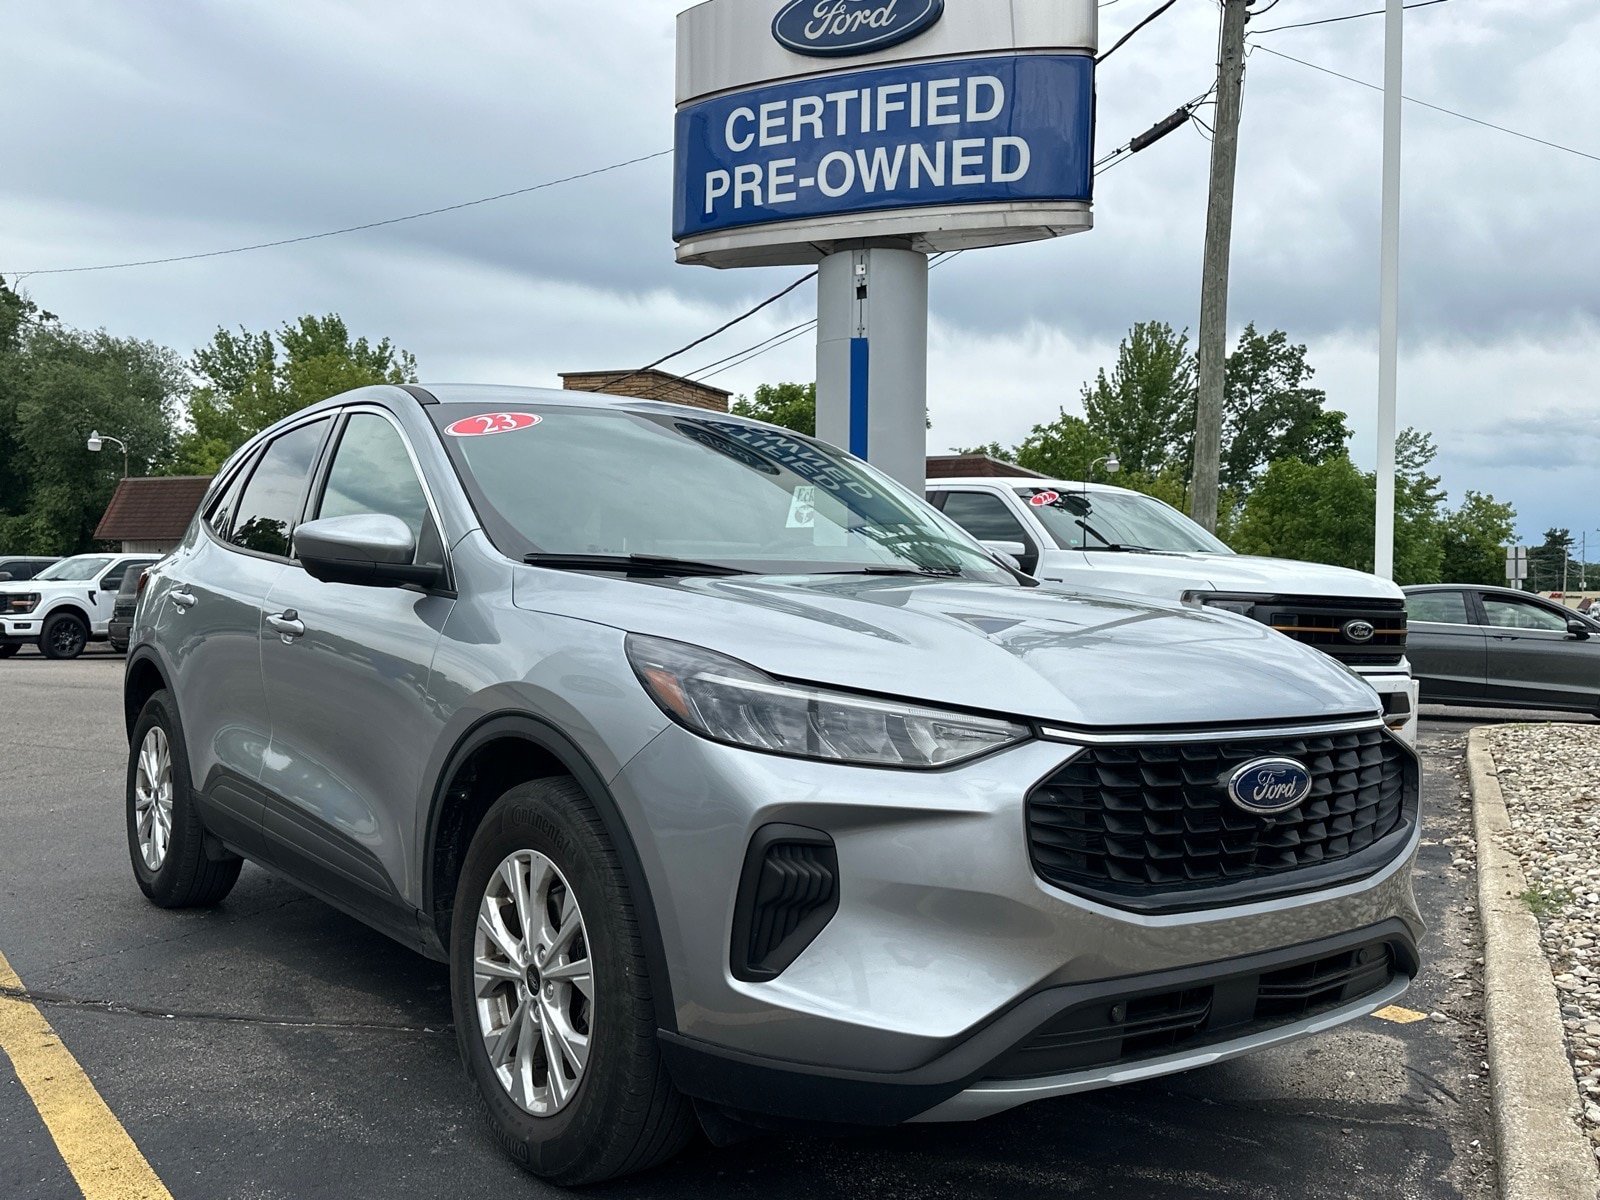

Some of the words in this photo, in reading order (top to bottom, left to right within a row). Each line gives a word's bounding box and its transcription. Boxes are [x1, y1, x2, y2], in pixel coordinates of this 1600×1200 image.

[804, 0, 897, 40] Ford
[725, 75, 1006, 153] CERTIFIED
[705, 136, 1031, 214] PRE-OWNED
[475, 413, 518, 433] 23
[1036, 492, 1054, 505] 22
[1353, 625, 1370, 636] Ford
[1253, 770, 1297, 801] Ford
[511, 804, 571, 855] Continental
